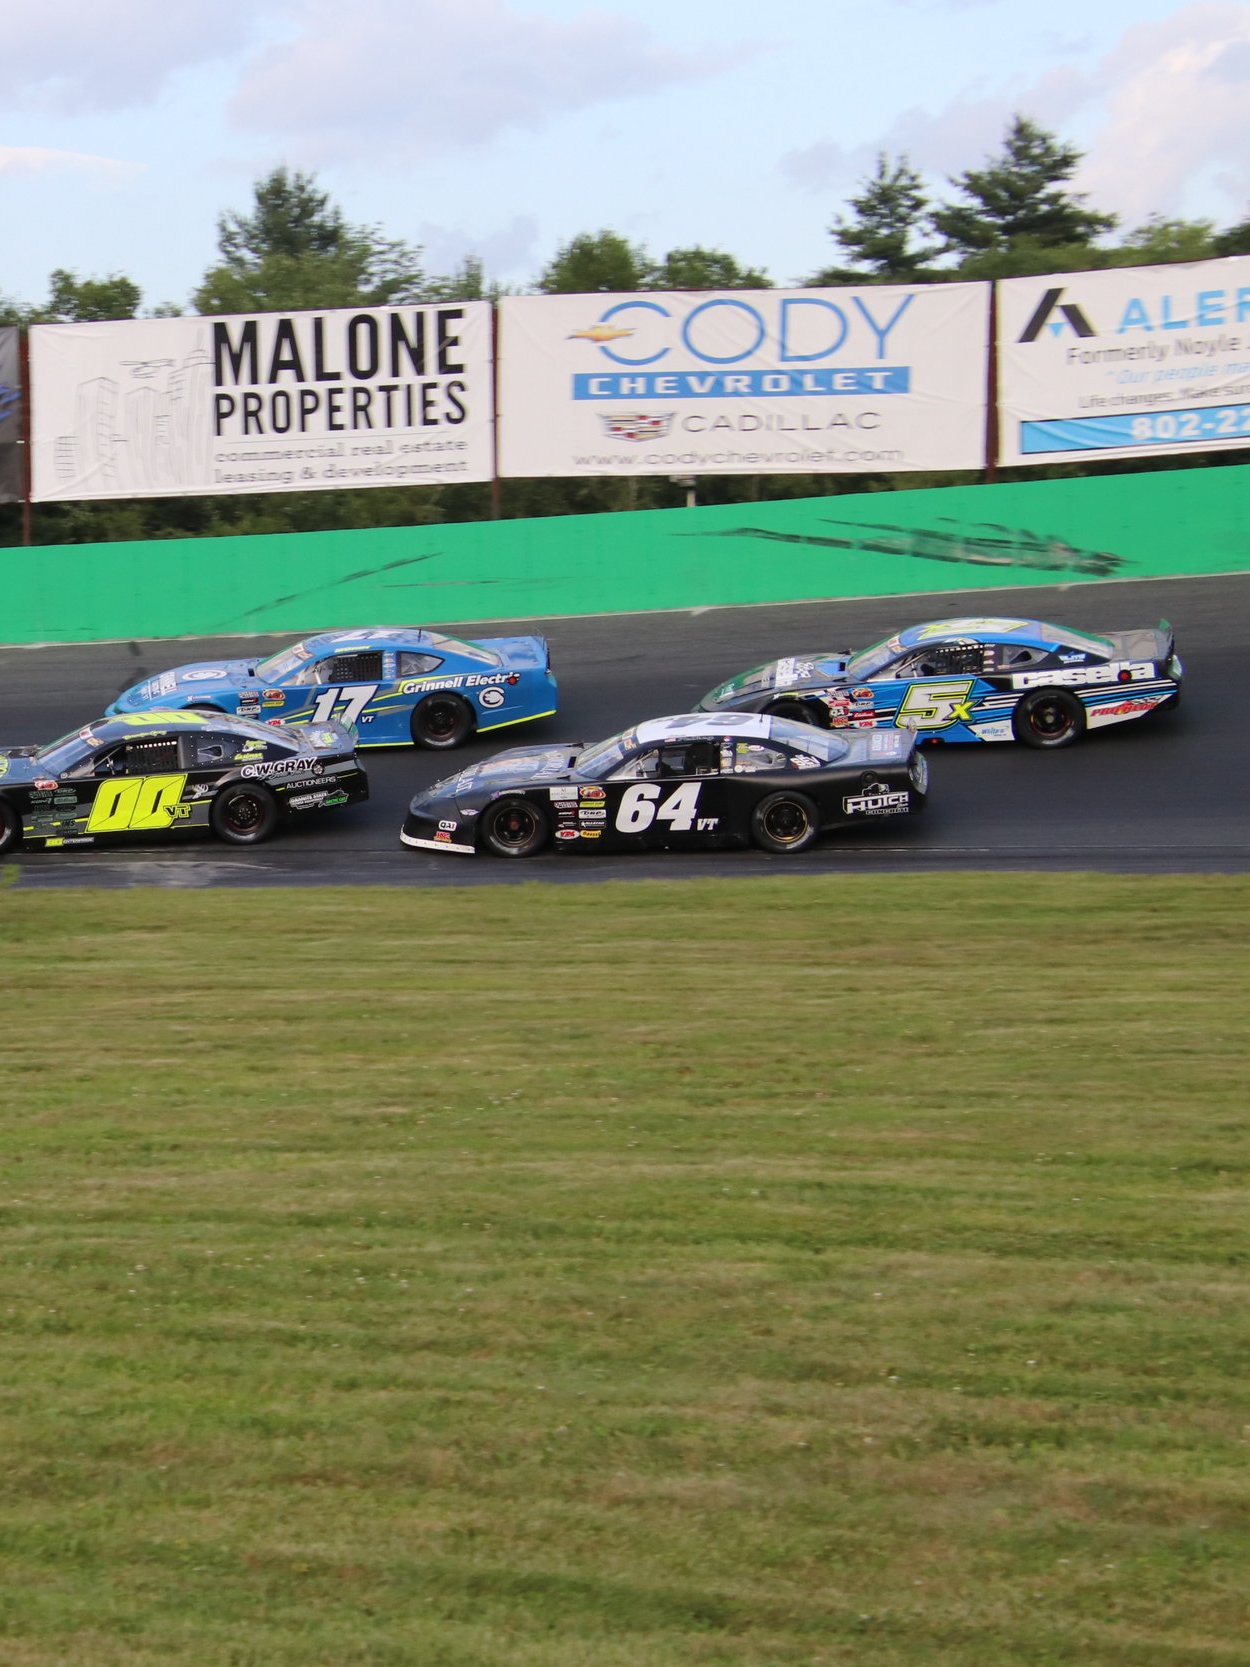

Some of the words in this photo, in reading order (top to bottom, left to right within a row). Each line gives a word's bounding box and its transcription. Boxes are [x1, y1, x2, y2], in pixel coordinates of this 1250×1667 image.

[598, 294, 914, 366] CODY
[212, 309, 466, 386] MALONE
[1067, 340, 1170, 365] Formerly
[587, 371, 894, 395] CHEVROLET
[214, 380, 468, 436] PROPERTIES
[681, 411, 883, 433] CADILLAC
[214, 442, 345, 463] commercial
[351, 440, 393, 457] real
[398, 437, 468, 455] estate
[572, 448, 905, 467] www.codychevrolet.com
[214, 467, 294, 485] leasing
[302, 466, 318, 480] &
[322, 459, 468, 481] development
[403, 676, 464, 694] Grinnell
[465, 672, 520, 687] Electri
[313, 684, 379, 724] 17
[286, 775, 337, 790] AUCTIONEERS
[85, 774, 188, 833] 00
[615, 782, 702, 833] 64
[847, 791, 909, 814] HUTCH
[697, 818, 718, 831] VT
